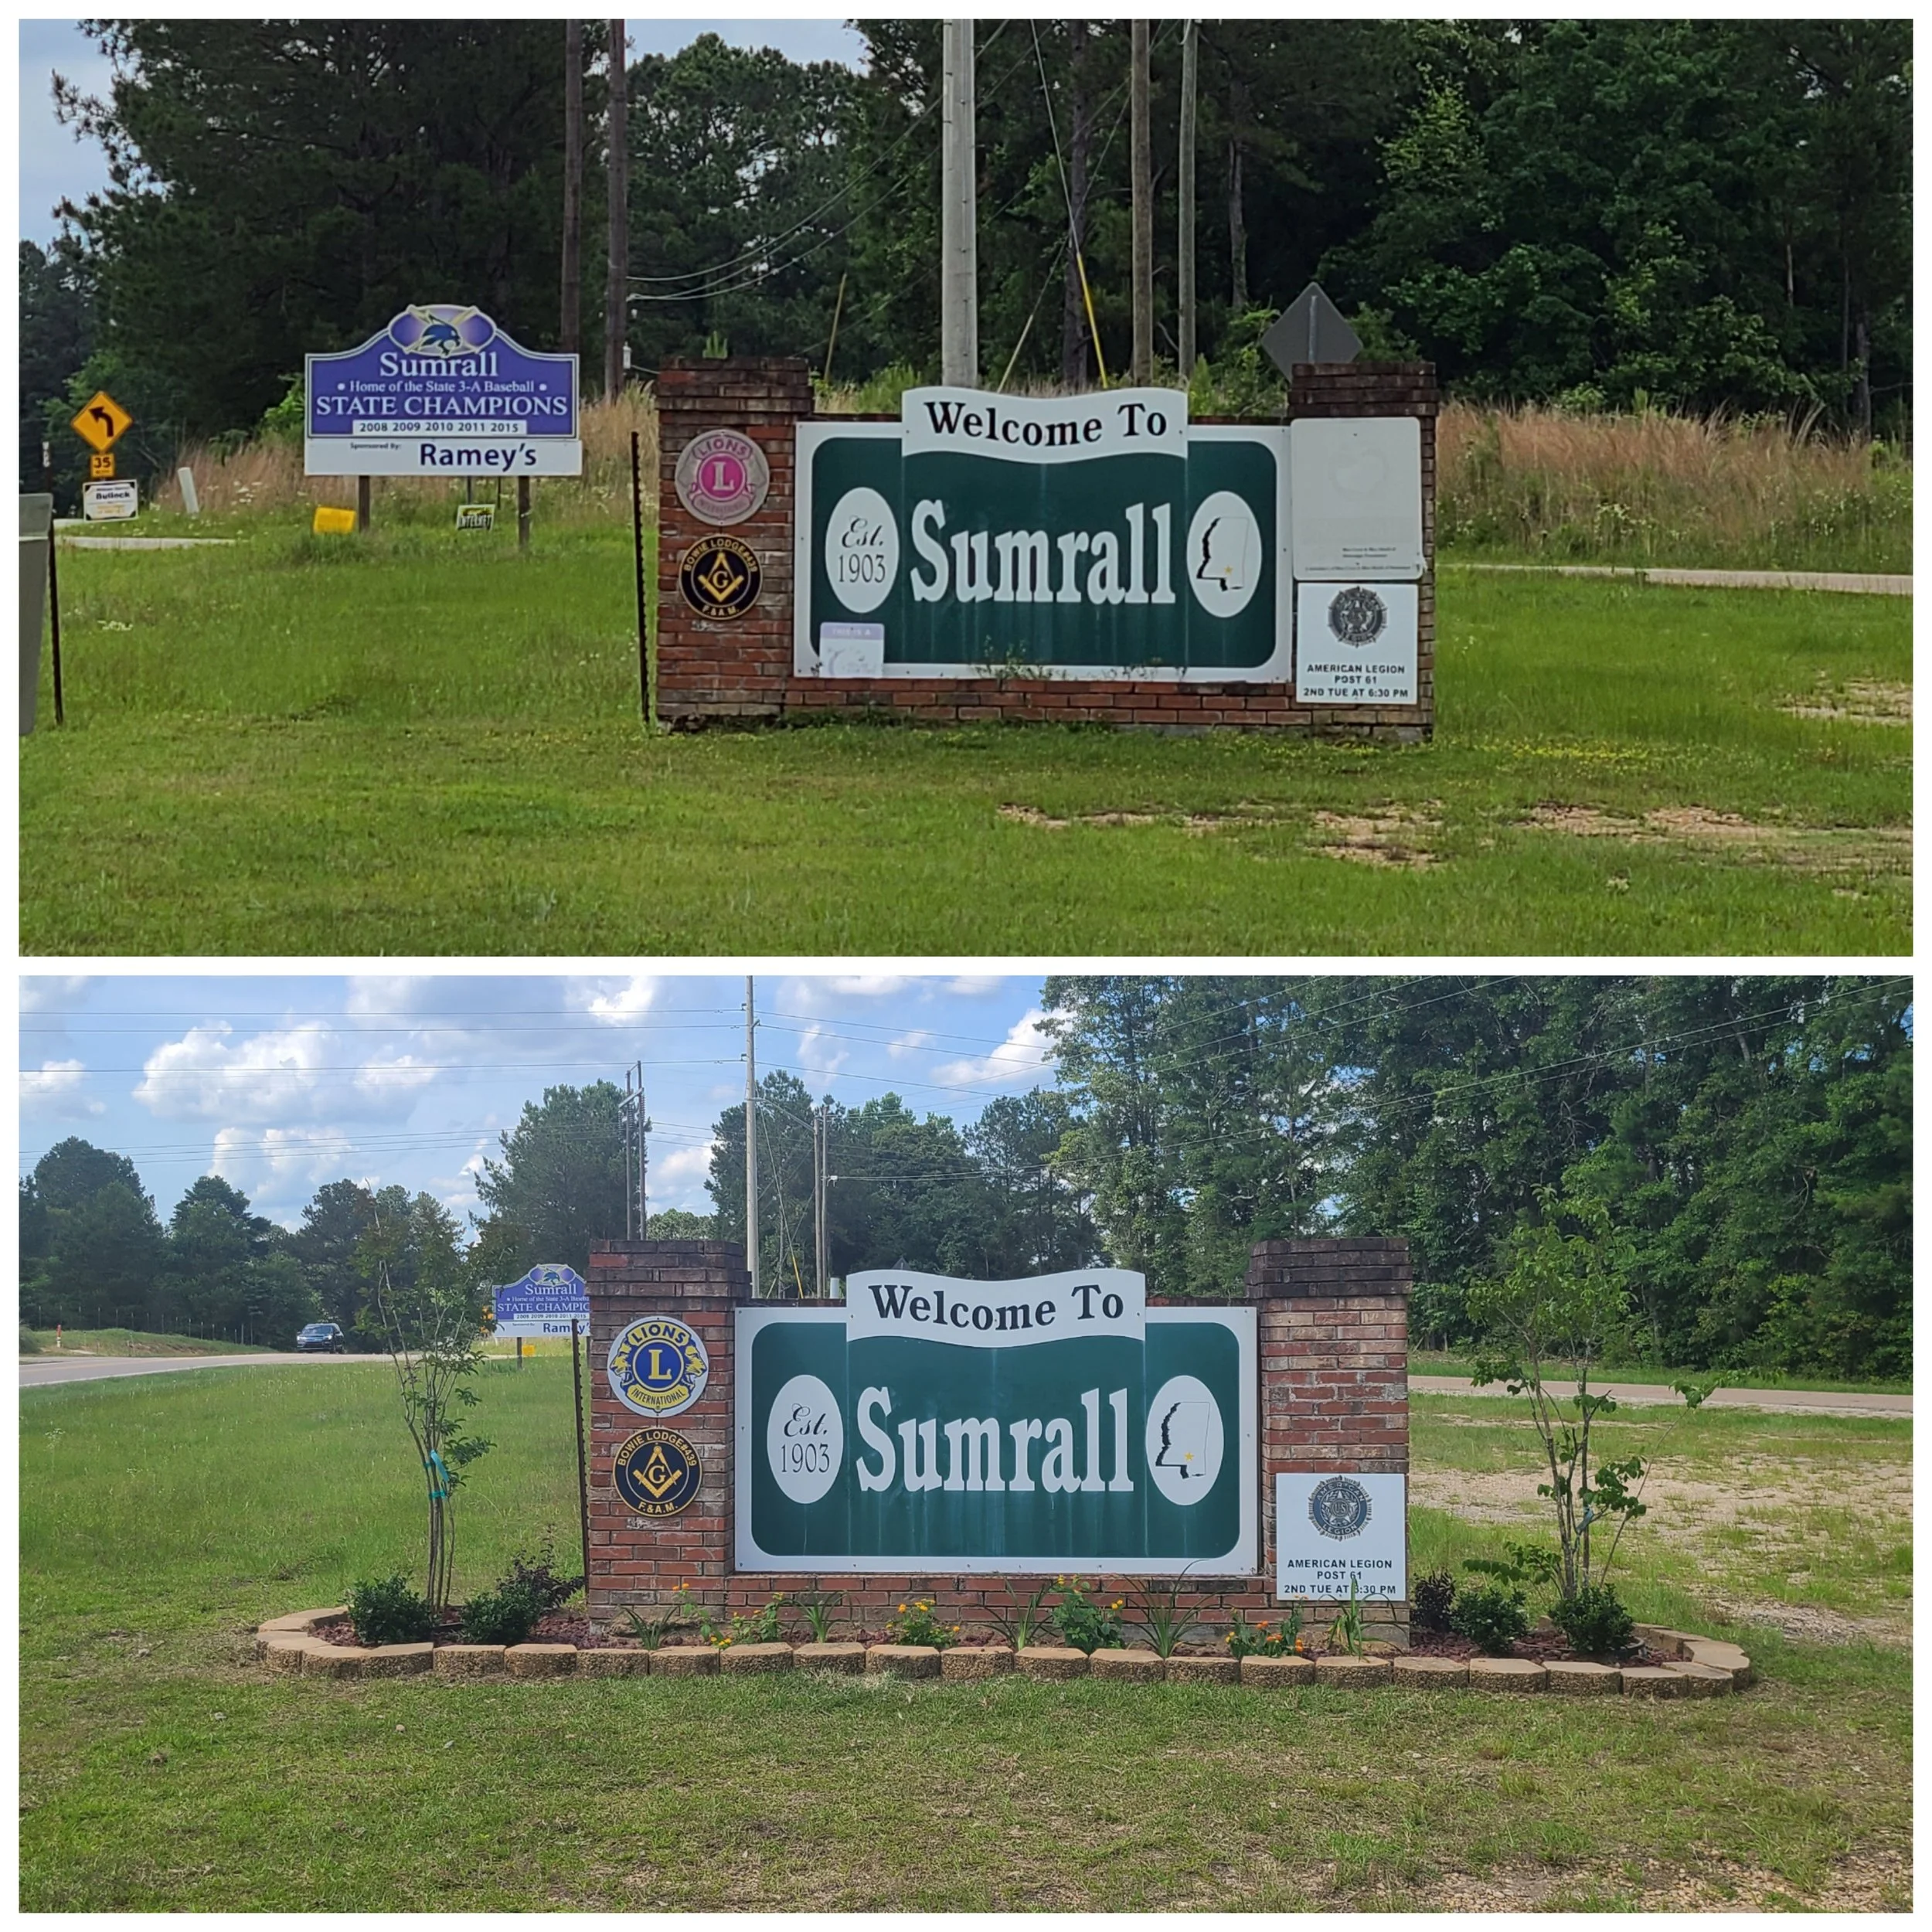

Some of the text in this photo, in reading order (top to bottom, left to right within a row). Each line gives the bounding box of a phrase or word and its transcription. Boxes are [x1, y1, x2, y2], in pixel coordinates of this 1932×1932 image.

[379, 352, 498, 377] Sumrall
[349, 380, 535, 393] Home of the State 3-A Baseball
[316, 396, 568, 416] STATE CHAMPIONS
[360, 422, 519, 433] 2008 2009 2010 2011 2015
[923, 401, 1168, 447] Welcome To
[697, 437, 747, 456] LIONS
[94, 457, 111, 468] 35
[420, 442, 537, 472] Ramey's
[713, 461, 735, 491] L
[842, 515, 884, 548] Est.
[684, 542, 709, 572] BOWIE
[910, 498, 1176, 605] Sumrall
[839, 553, 886, 583] 1903
[713, 570, 729, 588] G
[1307, 664, 1405, 674] AMERICAN LEGION
[1335, 675, 1377, 685] POST 61
[1304, 688, 1408, 698] 2ND TUE AT 6:30 PM
[525, 1284, 577, 1295] Sumrall
[497, 1303, 533, 1312] STATE
[868, 1284, 1124, 1331] Welcome To
[631, 1324, 686, 1344] LIONS
[648, 1349, 672, 1380] L
[631, 1388, 686, 1405] INTERNATIONAL
[784, 1403, 828, 1437] Est.
[855, 1386, 1134, 1493] Sumrall
[617, 1435, 645, 1466] BOWIE
[781, 1443, 830, 1473] 1903
[648, 1465, 666, 1484] G
[1317, 1481, 1366, 1502] AMERICAN
[1322, 1524, 1358, 1535] LEGION
[1287, 1560, 1392, 1569] AMERICAN LEGION
[1317, 1571, 1362, 1580] POST 61
[1284, 1585, 1306, 1594] 2ND
[1310, 1585, 1332, 1594] TUE
[1335, 1585, 1349, 1594] AT
[1380, 1585, 1396, 1594] PM
